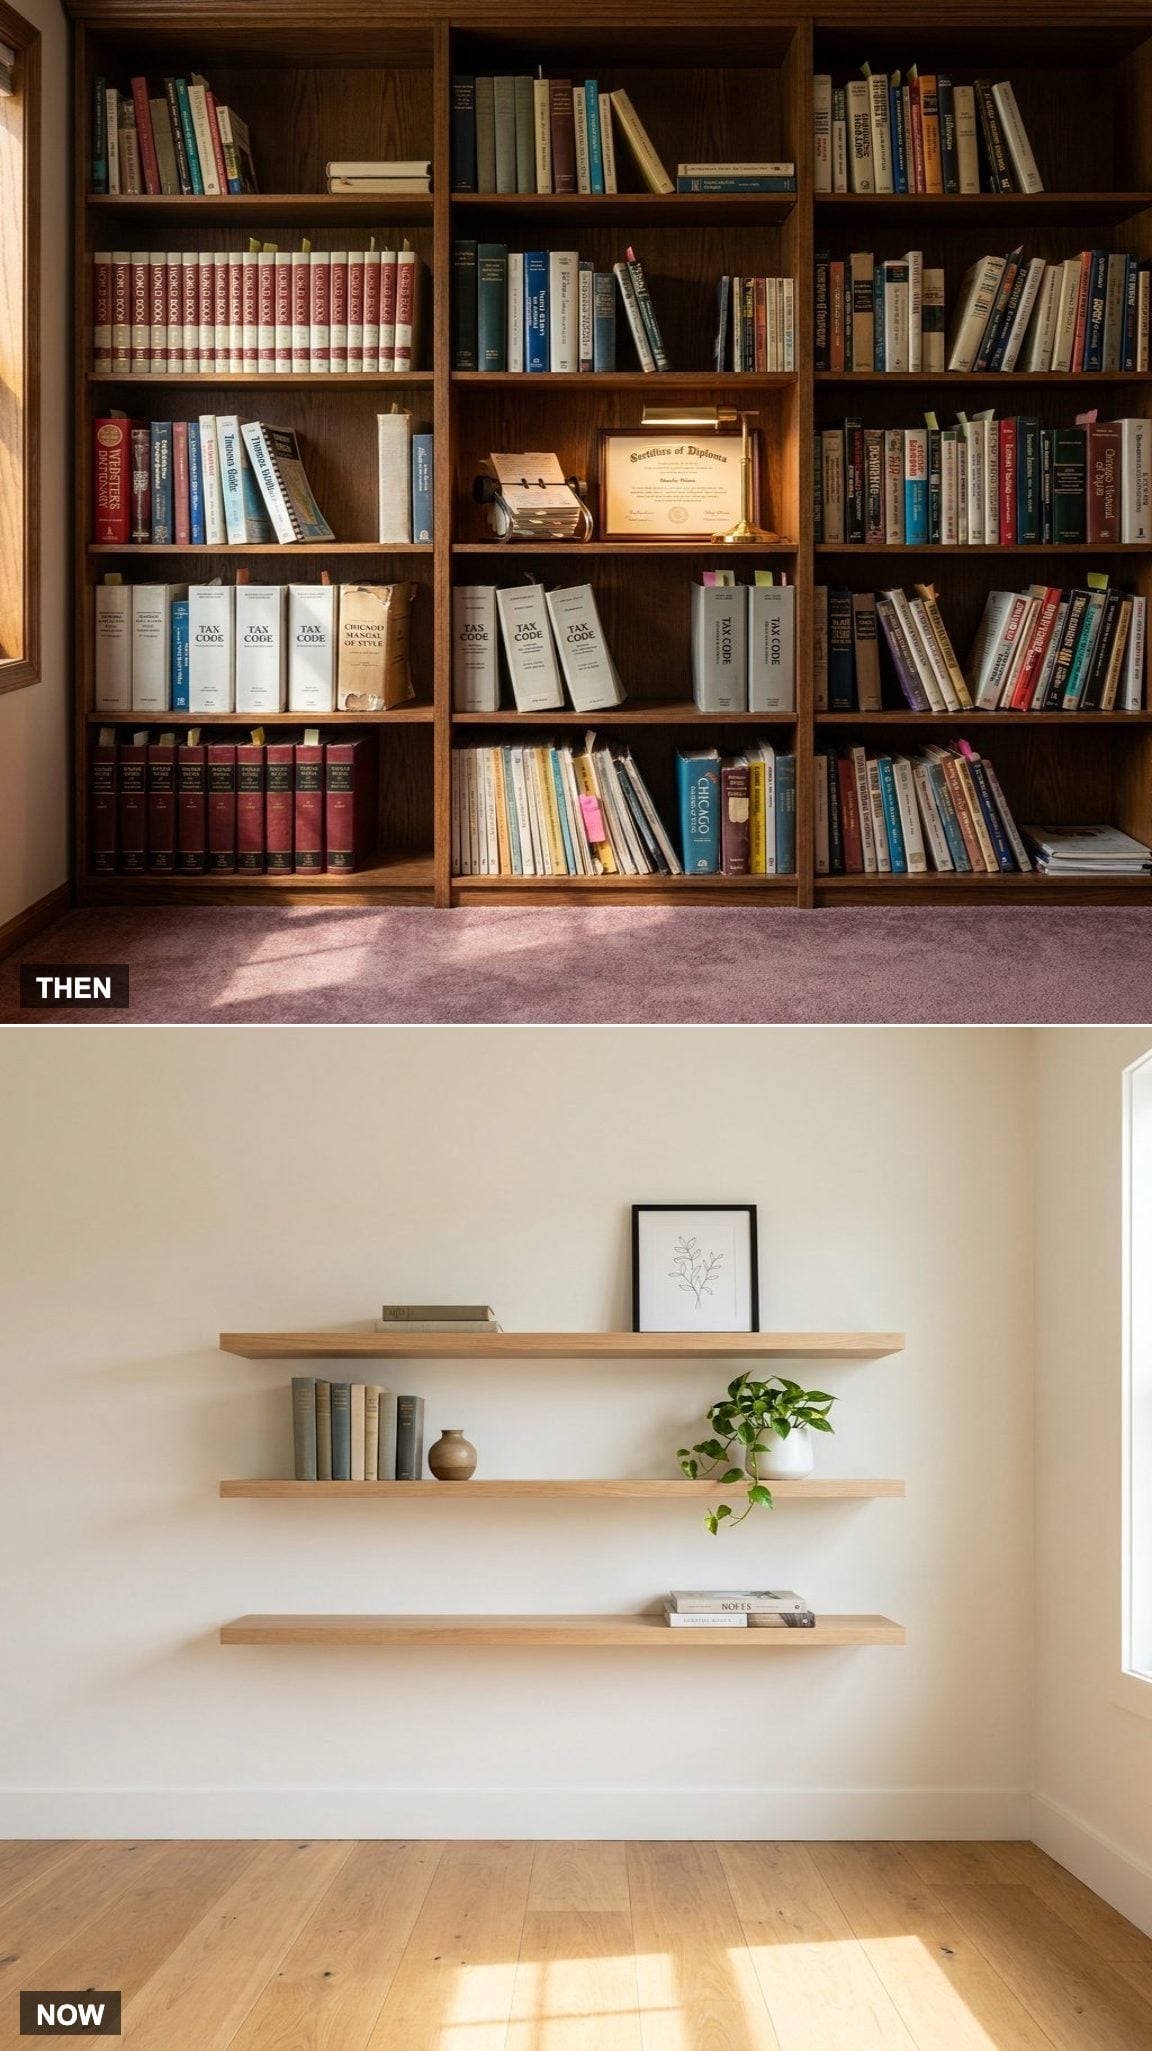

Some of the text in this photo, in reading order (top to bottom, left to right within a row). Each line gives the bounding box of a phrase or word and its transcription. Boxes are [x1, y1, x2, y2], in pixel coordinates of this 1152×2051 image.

[687, 446, 727, 463] Diploma
[199, 625, 220, 633] TAX
[300, 625, 321, 633] TAX
[516, 622, 537, 632] TAX
[568, 623, 589, 634] TAX
[195, 634, 224, 642] CODE
[244, 635, 273, 643] CODE
[297, 634, 326, 642] CODE
[460, 633, 488, 641] CODE
[514, 630, 543, 642] CODE
[567, 630, 596, 643] CODE
[722, 617, 732, 665] TAX CODE
[771, 617, 780, 665] TAX CODE
[698, 777, 709, 834] CHICAGO
